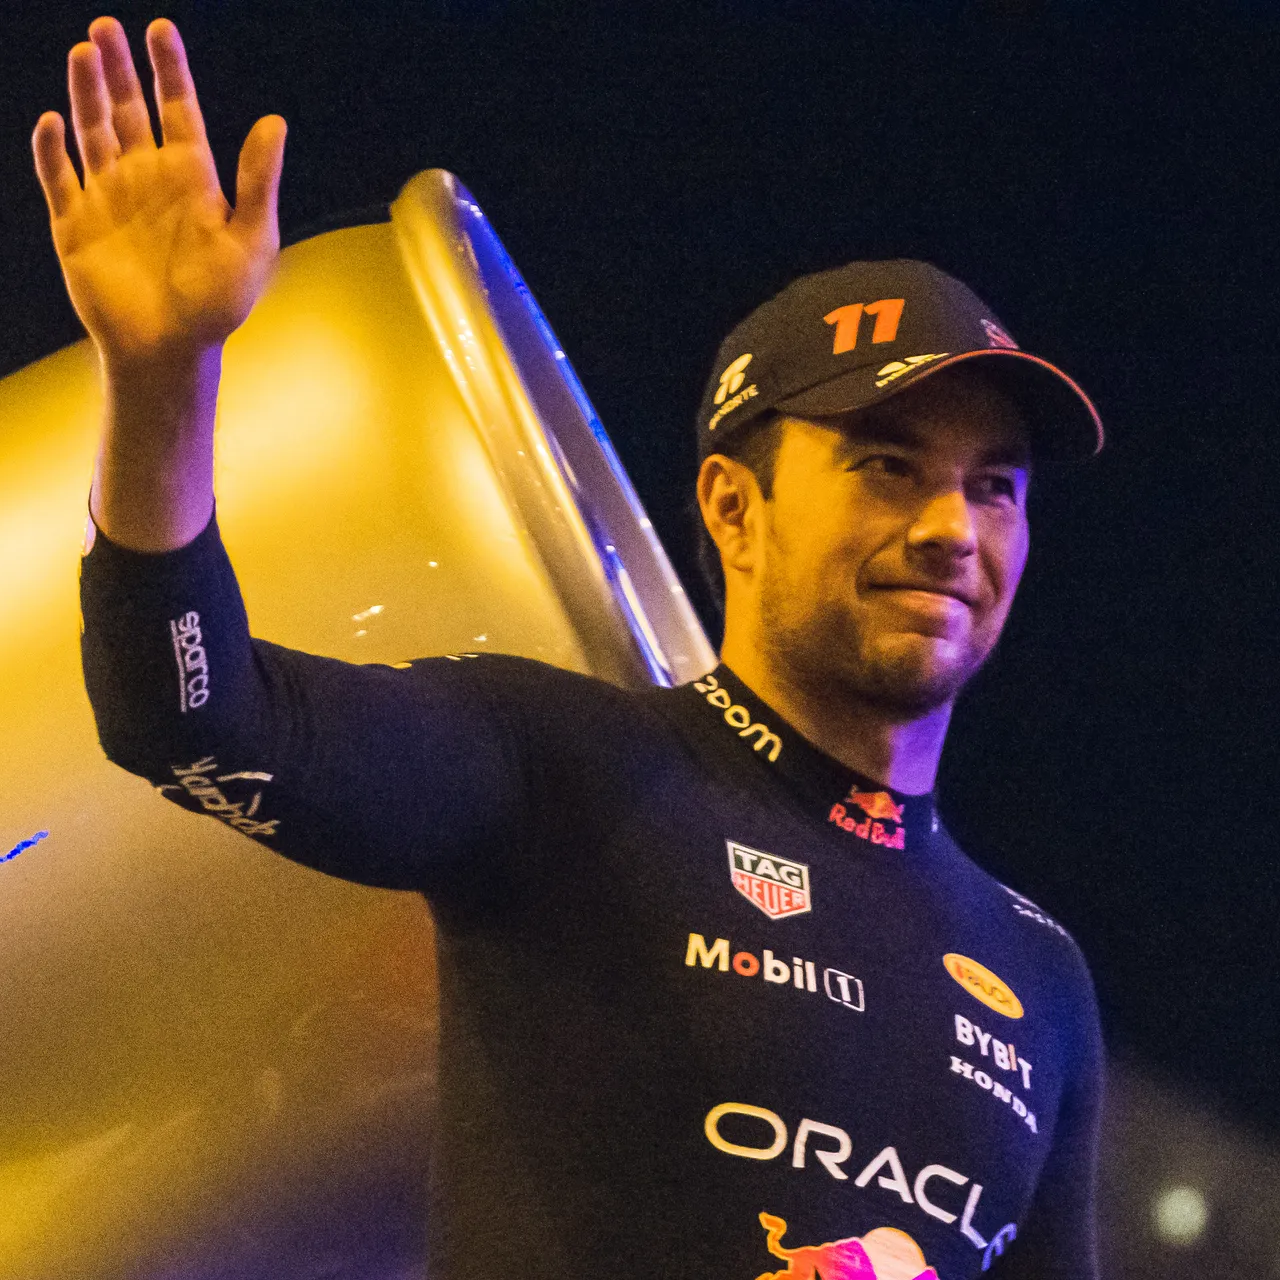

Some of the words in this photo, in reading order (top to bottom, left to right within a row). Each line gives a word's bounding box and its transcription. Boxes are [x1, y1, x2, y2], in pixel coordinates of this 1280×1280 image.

[824, 299, 905, 354] 11
[174, 611, 210, 710] sparco
[733, 873, 806, 914] HEUER
[735, 848, 802, 888] TAG
[685, 933, 816, 992] Mobil
[955, 1014, 1032, 1089] BYBIT
[950, 1056, 1038, 1134] HONDA
